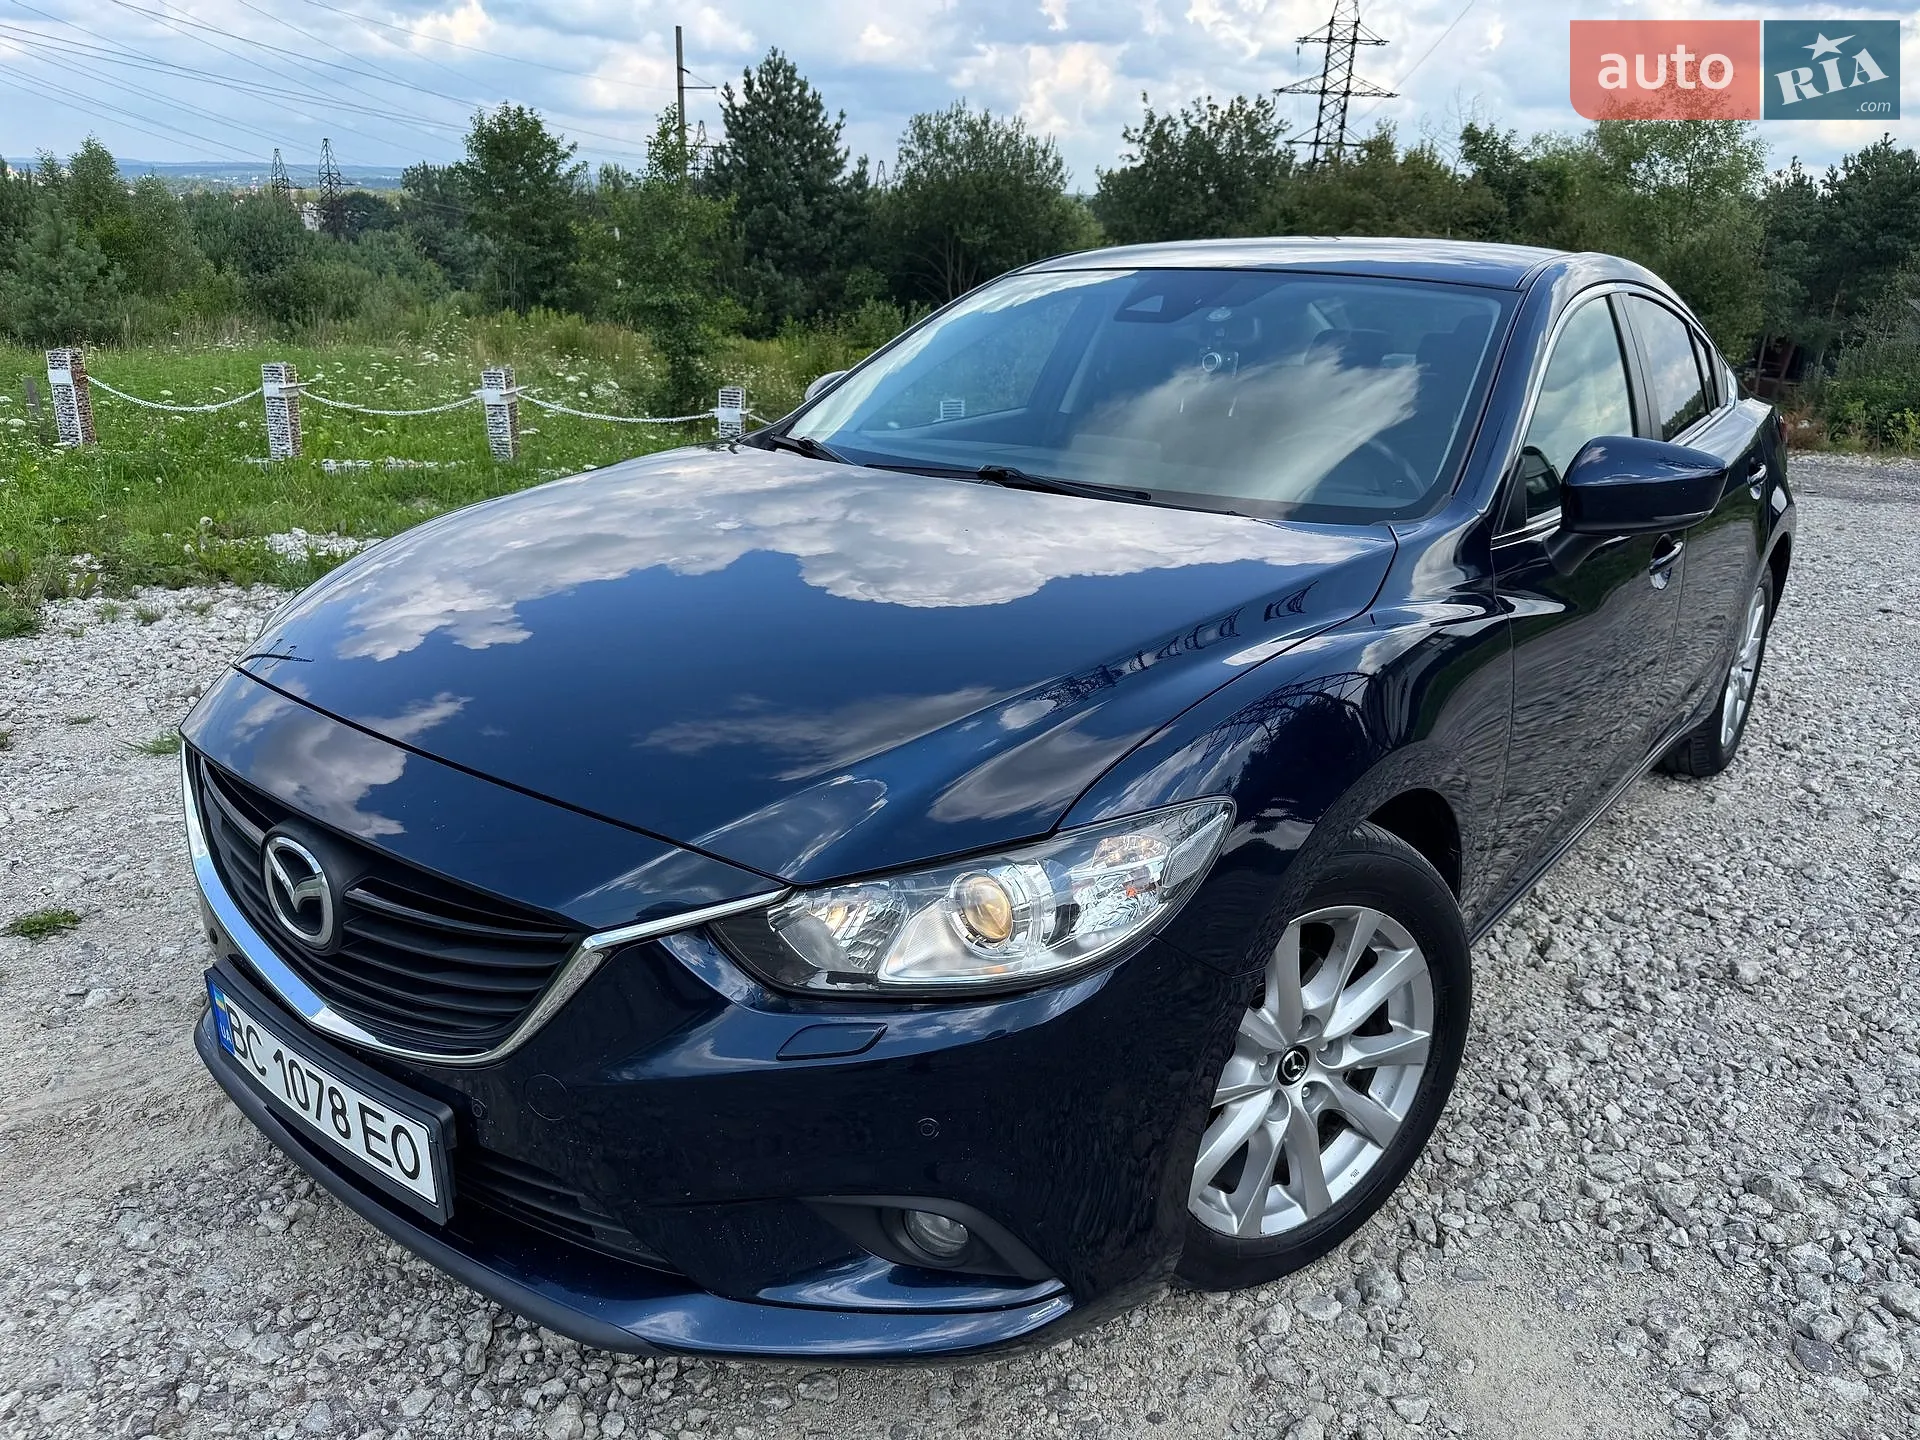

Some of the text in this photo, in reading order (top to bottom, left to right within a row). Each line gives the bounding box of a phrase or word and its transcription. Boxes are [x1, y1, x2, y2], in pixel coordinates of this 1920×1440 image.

[219, 1021, 233, 1045] UA
[227, 1003, 421, 1180] BC 1078 EO
